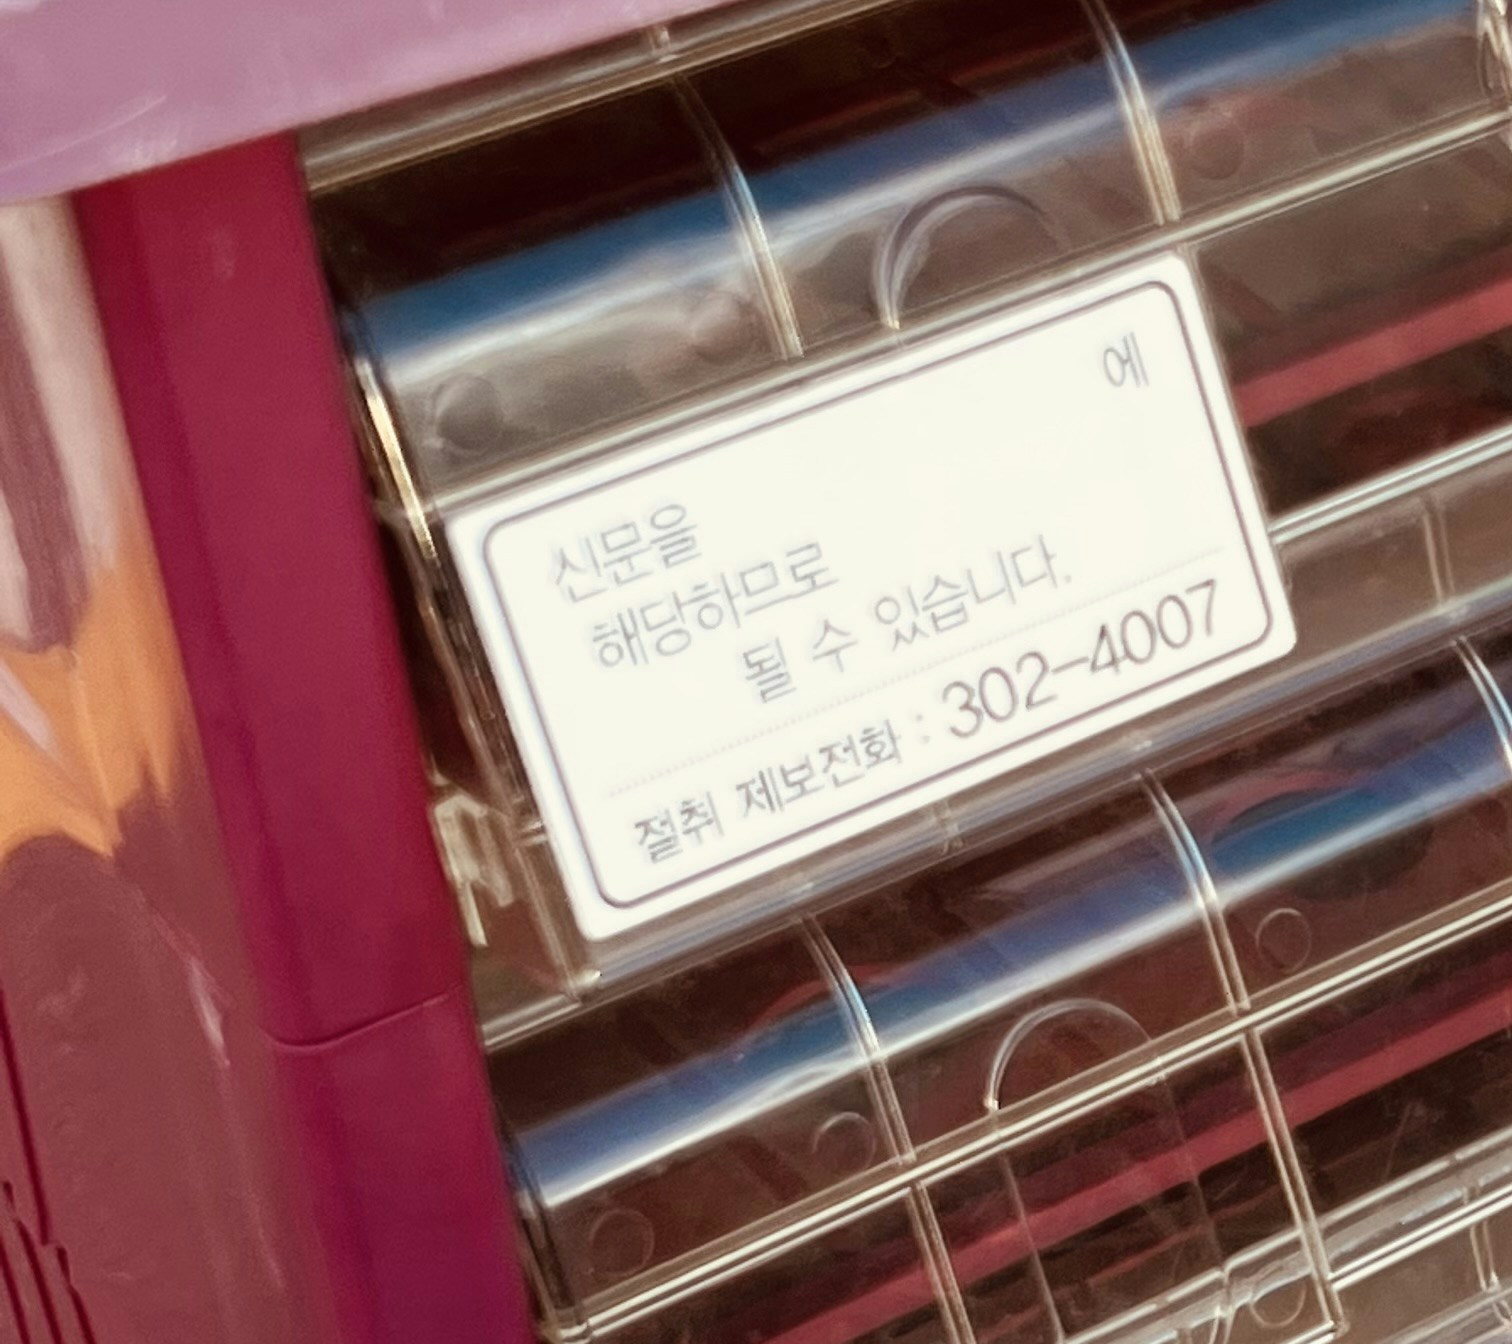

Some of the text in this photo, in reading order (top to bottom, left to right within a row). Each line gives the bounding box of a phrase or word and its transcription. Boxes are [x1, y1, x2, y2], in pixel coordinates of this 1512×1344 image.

[1102, 332, 1149, 389] 에
[552, 502, 704, 603] 신문을
[592, 541, 840, 670] 해당하므로
[742, 533, 1073, 704] 될 수 있습니다.
[633, 798, 725, 863] 절취
[942, 579, 1223, 740] 302-4007
